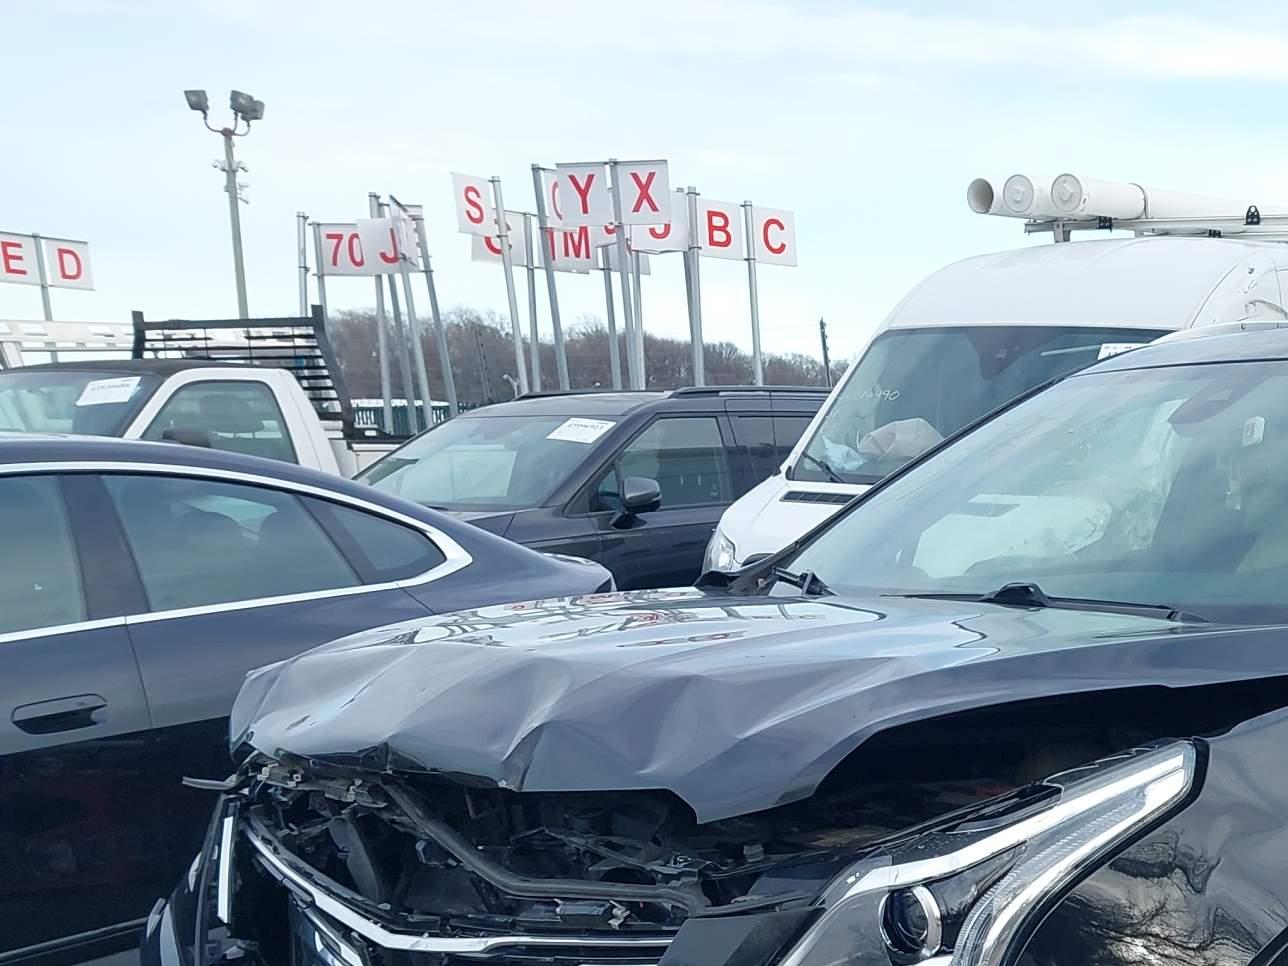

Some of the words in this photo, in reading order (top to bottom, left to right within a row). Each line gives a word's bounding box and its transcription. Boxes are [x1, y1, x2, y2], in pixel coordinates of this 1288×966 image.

[464, 185, 485, 224] S
[568, 174, 596, 214] Y
[630, 171, 660, 213] X
[379, 227, 400, 265] J
[563, 226, 592, 260] M
[706, 210, 732, 248] B
[763, 218, 787, 255] C
[0, 241, 28, 276] E
[57, 248, 82, 280] D
